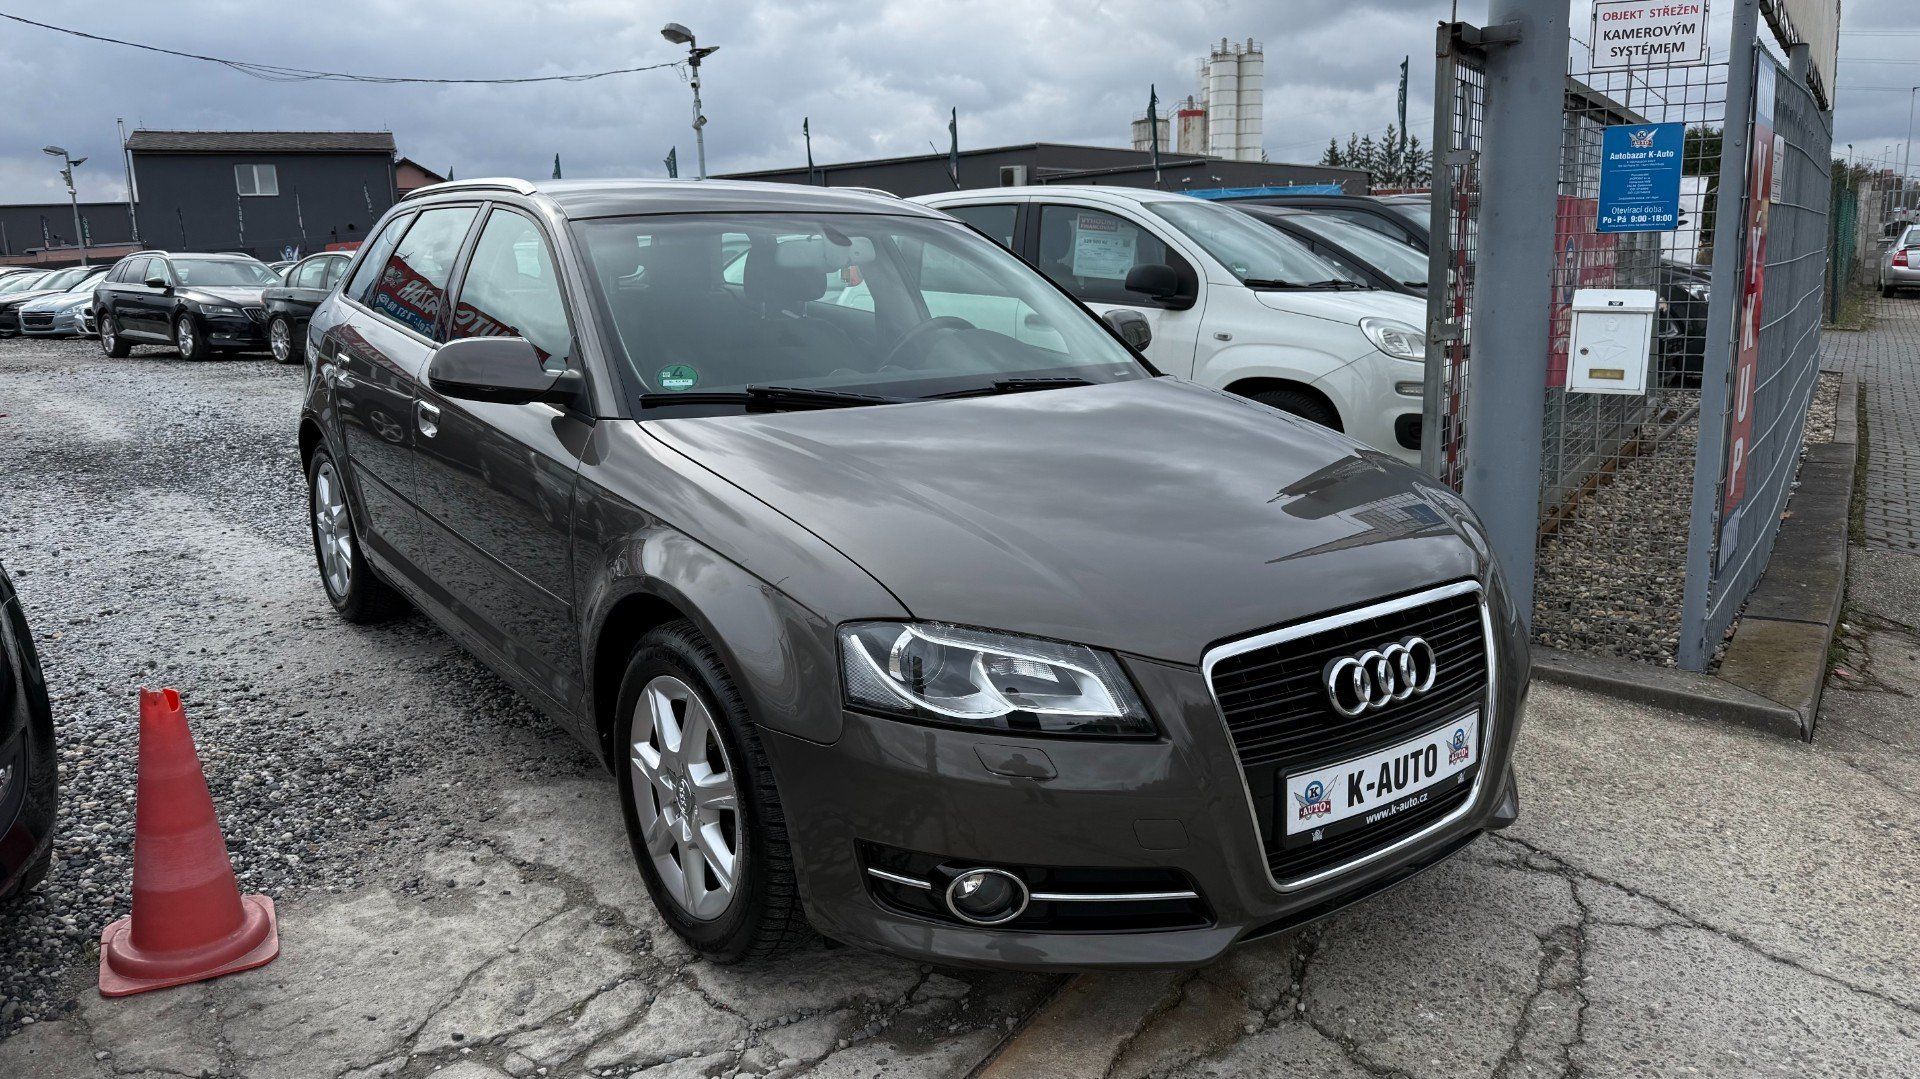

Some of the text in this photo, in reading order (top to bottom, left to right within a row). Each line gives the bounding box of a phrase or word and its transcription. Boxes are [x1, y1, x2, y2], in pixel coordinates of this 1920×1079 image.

[1602, 4, 1699, 22] OBJEKT STŘEŽEN
[1603, 22, 1696, 41] KAMEROVÝM
[1610, 41, 1686, 58] SYSTÉMEM
[1609, 149, 1674, 161] Autobazar K-Auto
[1611, 204, 1664, 215] Otevírací doba:
[1602, 216, 1612, 224] Po
[1617, 214, 1627, 223] Pá
[1347, 743, 1439, 808] K-AUTO
[1309, 786, 1320, 799] K
[1302, 801, 1328, 816] AUTO
[1365, 792, 1428, 825] www.k-auto.cz
